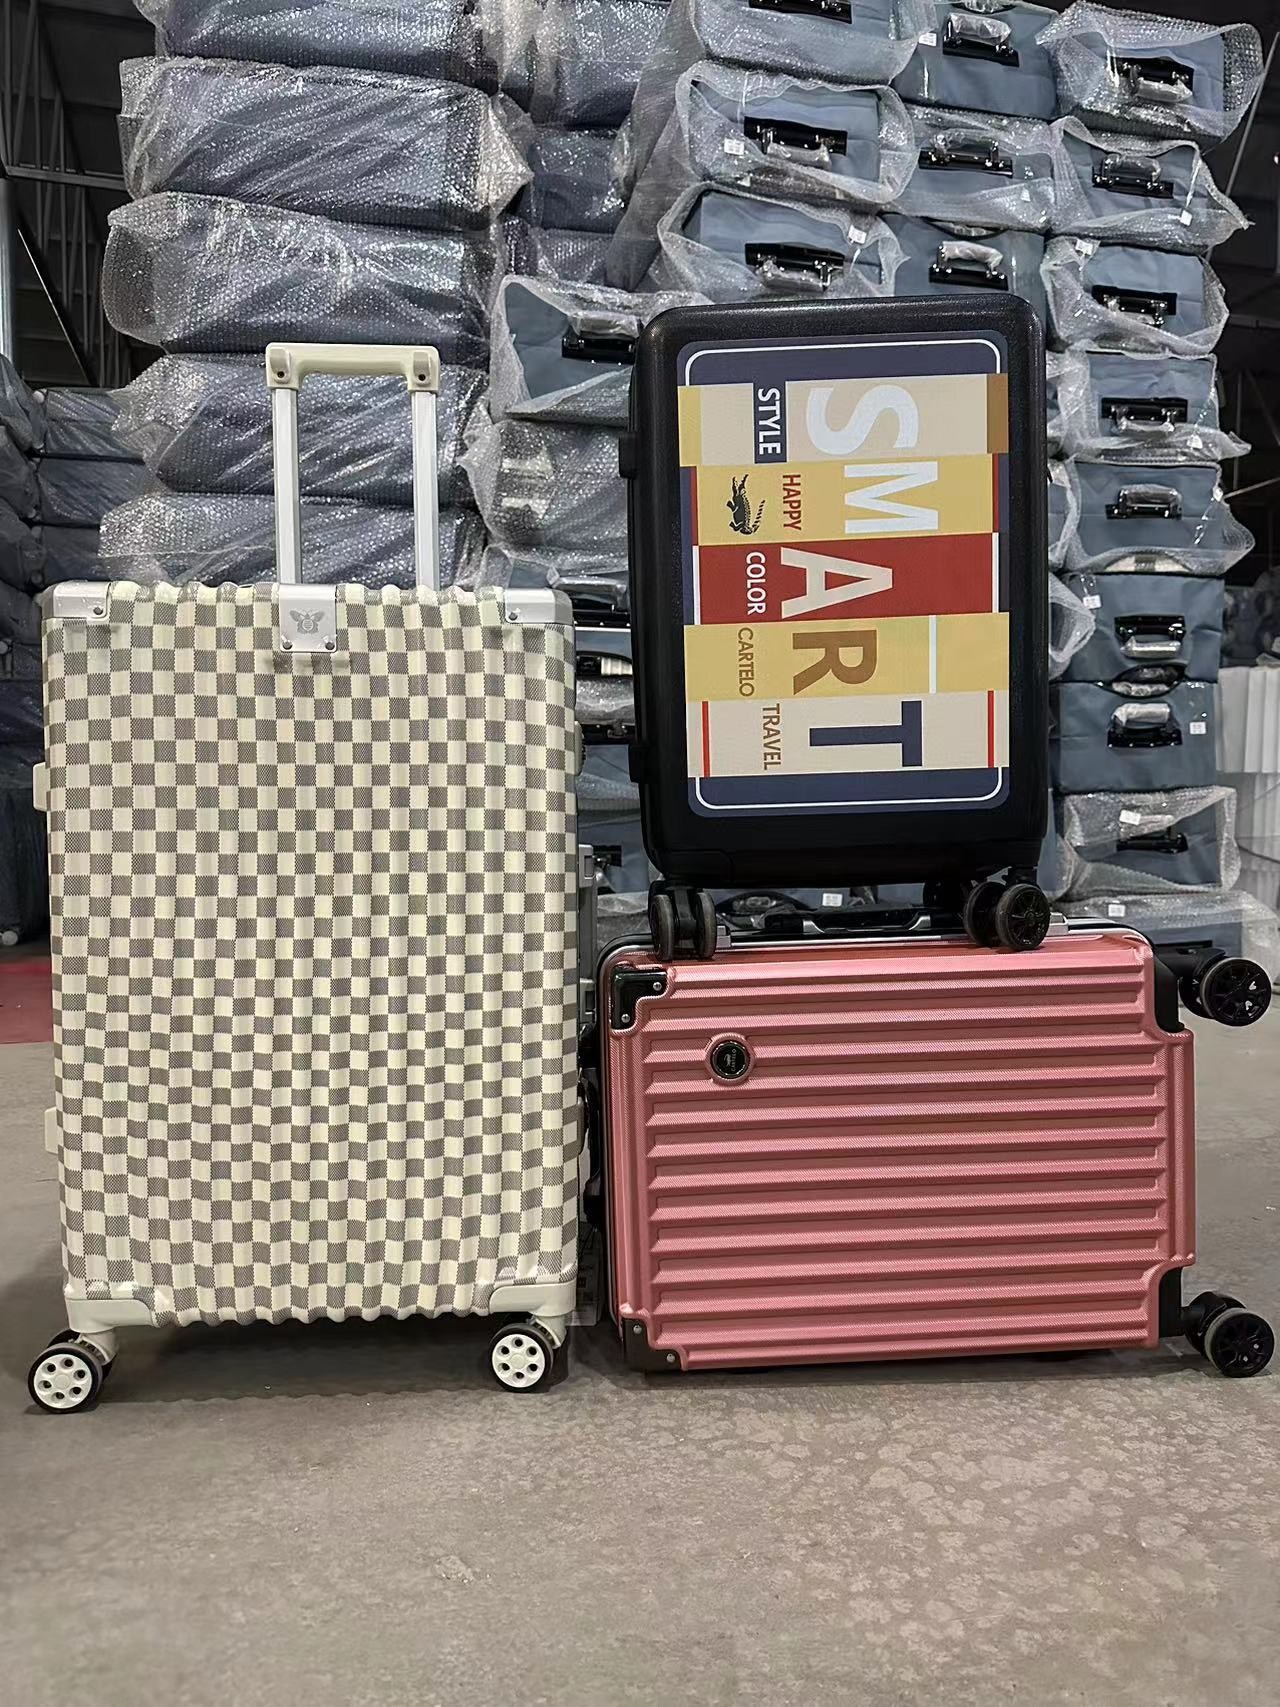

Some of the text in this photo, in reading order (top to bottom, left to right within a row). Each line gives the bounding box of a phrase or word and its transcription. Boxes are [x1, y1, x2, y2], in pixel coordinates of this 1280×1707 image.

[758, 388, 781, 456] STYLE
[783, 473, 802, 531] HAPPY
[746, 551, 768, 616] COLOR
[780, 383, 939, 767] SMART
[738, 627, 755, 697] CARTELO
[763, 703, 781, 770] TRAVEL
